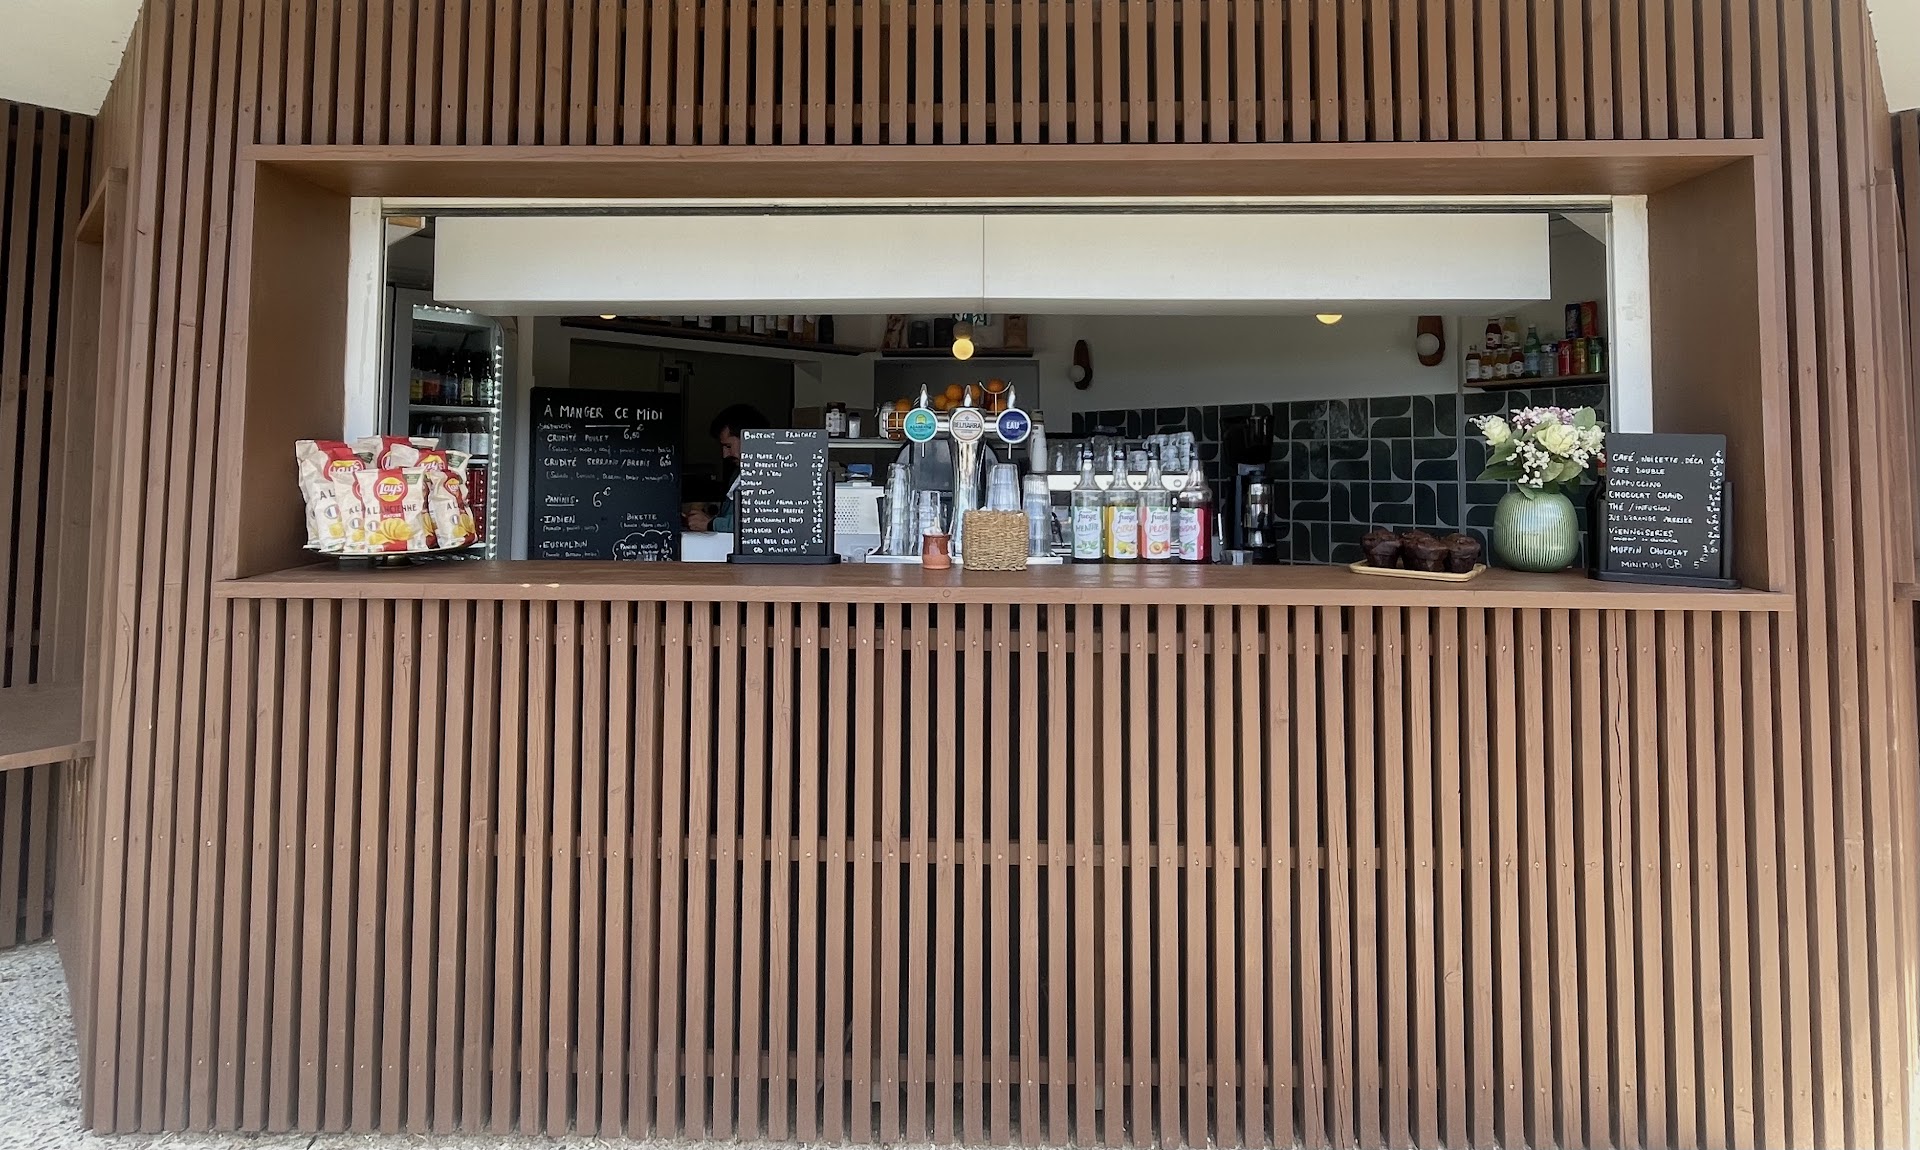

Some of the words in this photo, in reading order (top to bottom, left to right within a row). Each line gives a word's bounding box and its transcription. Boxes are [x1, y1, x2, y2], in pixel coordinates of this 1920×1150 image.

[544, 398, 553, 418] À
[560, 405, 604, 419] MANGER
[615, 407, 629, 419] CE
[1006, 421, 1020, 430] EAU
[1612, 465, 1630, 474] CAFÉ
[1636, 467, 1665, 475] DOUBLE
[380, 483, 402, 496] Lay's
[1608, 490, 1651, 499] CHOCOLAT
[1657, 491, 1684, 501] CHAUD
[1608, 502, 1624, 511] THÉ
[1649, 546, 1689, 556] CHOCOLAT
[1665, 557, 1682, 569] CB
